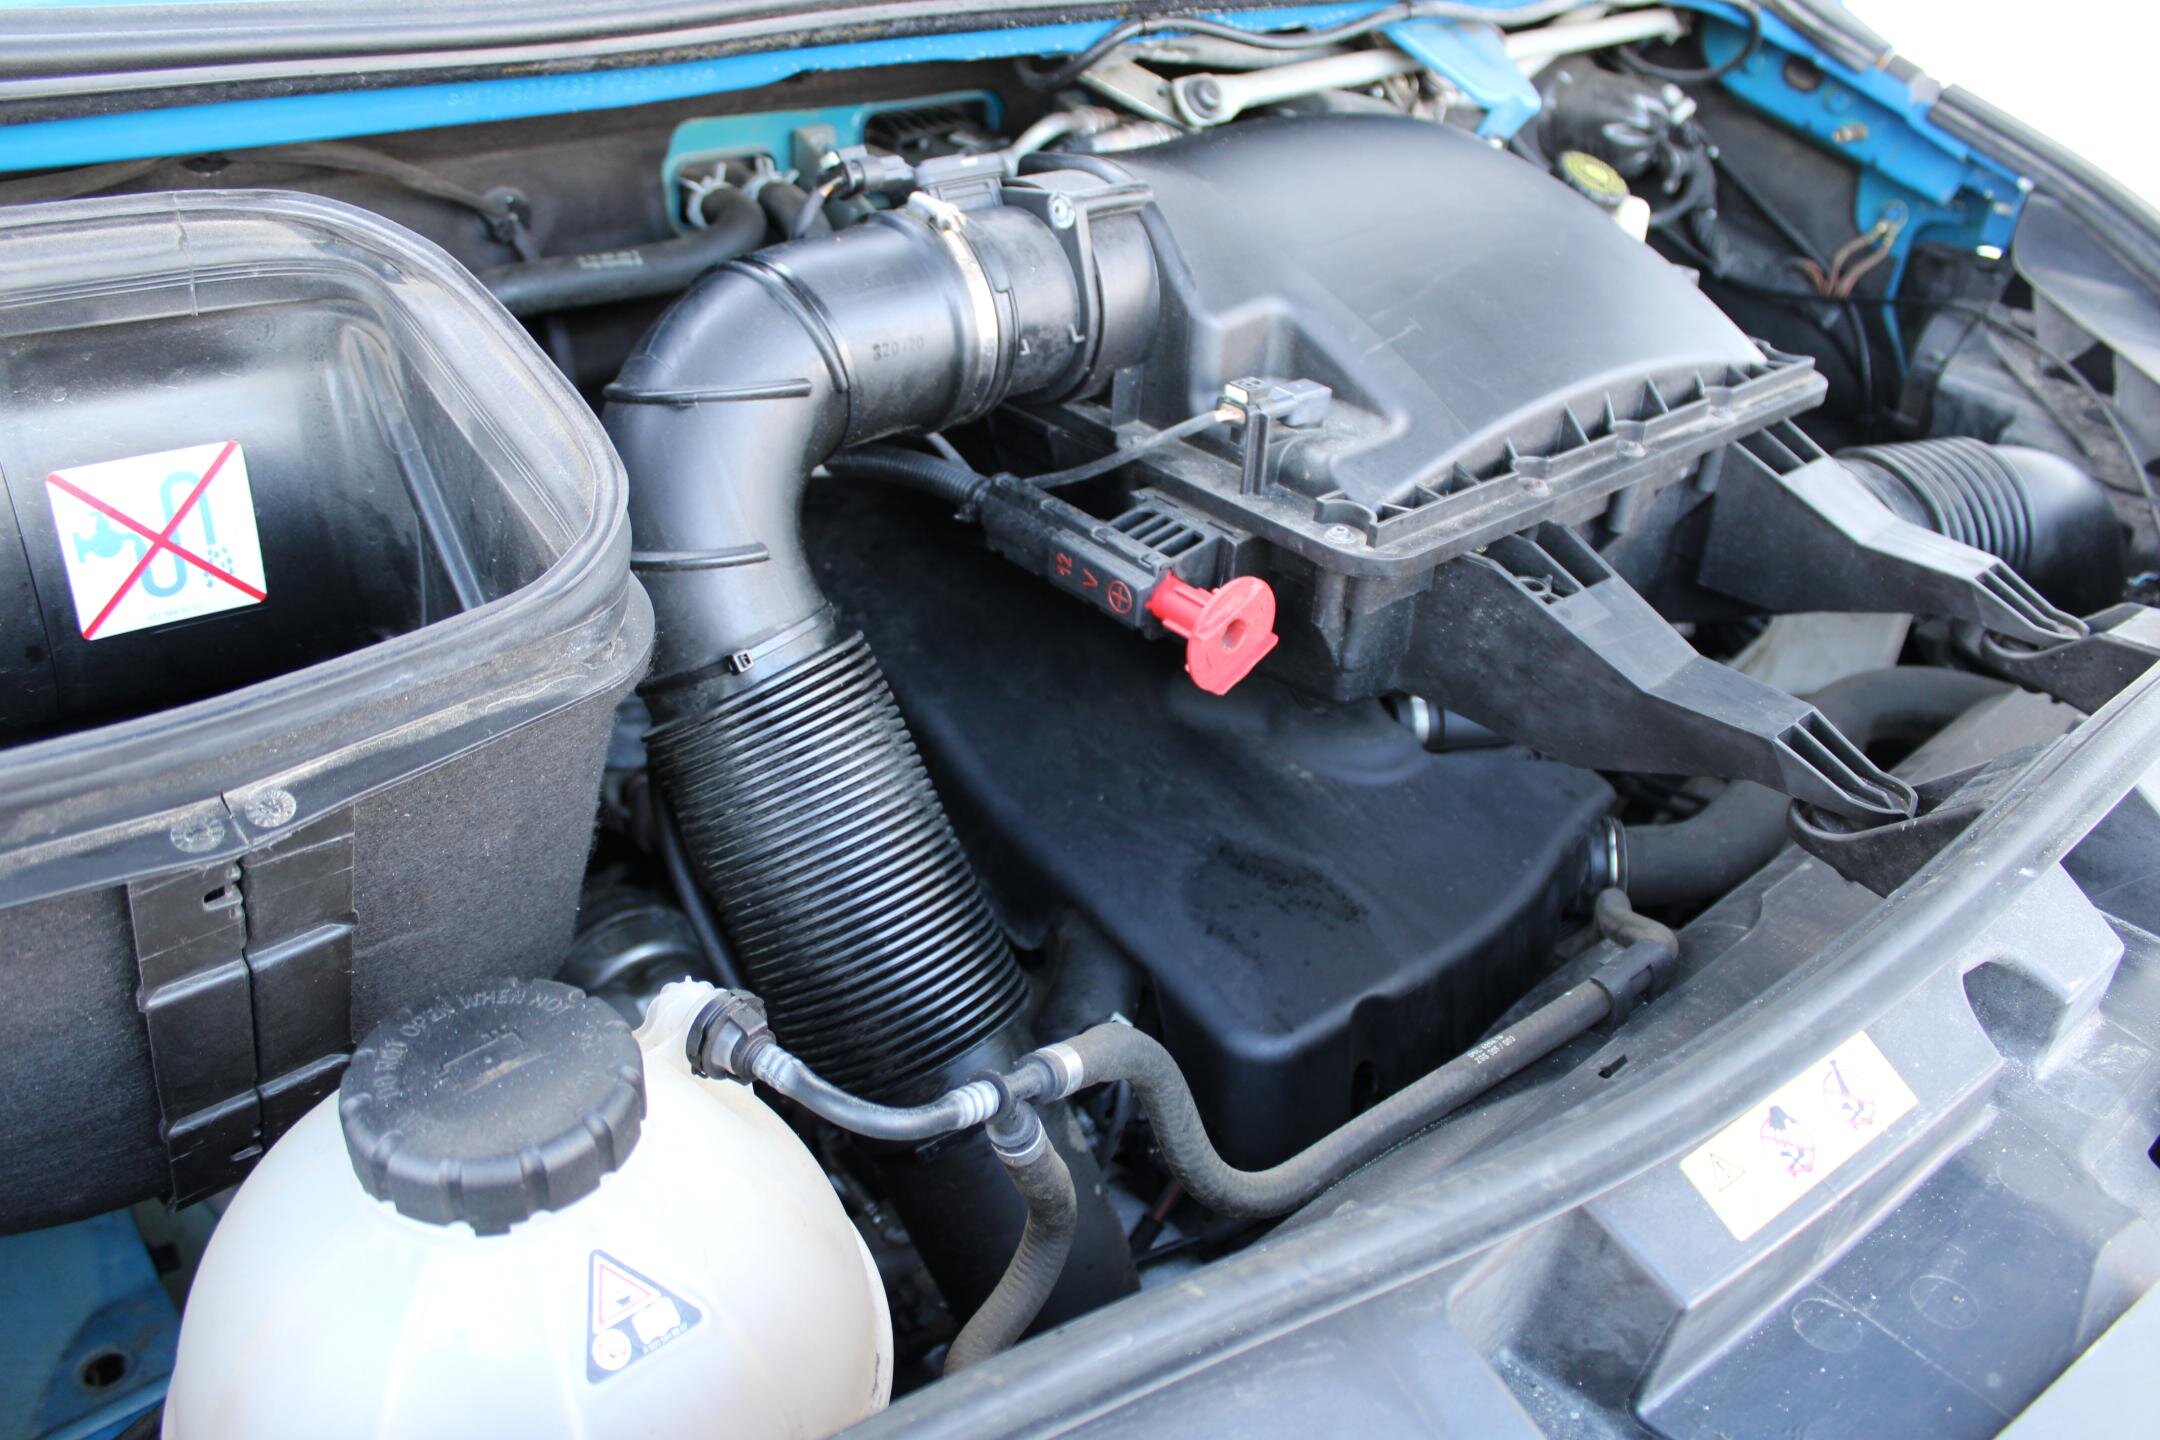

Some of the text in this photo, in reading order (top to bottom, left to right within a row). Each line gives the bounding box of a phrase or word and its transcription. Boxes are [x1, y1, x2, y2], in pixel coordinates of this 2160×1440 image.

[1056, 552, 1098, 588] 12 V
[374, 988, 572, 1100] DO NOT OPEN WHEN HOT
